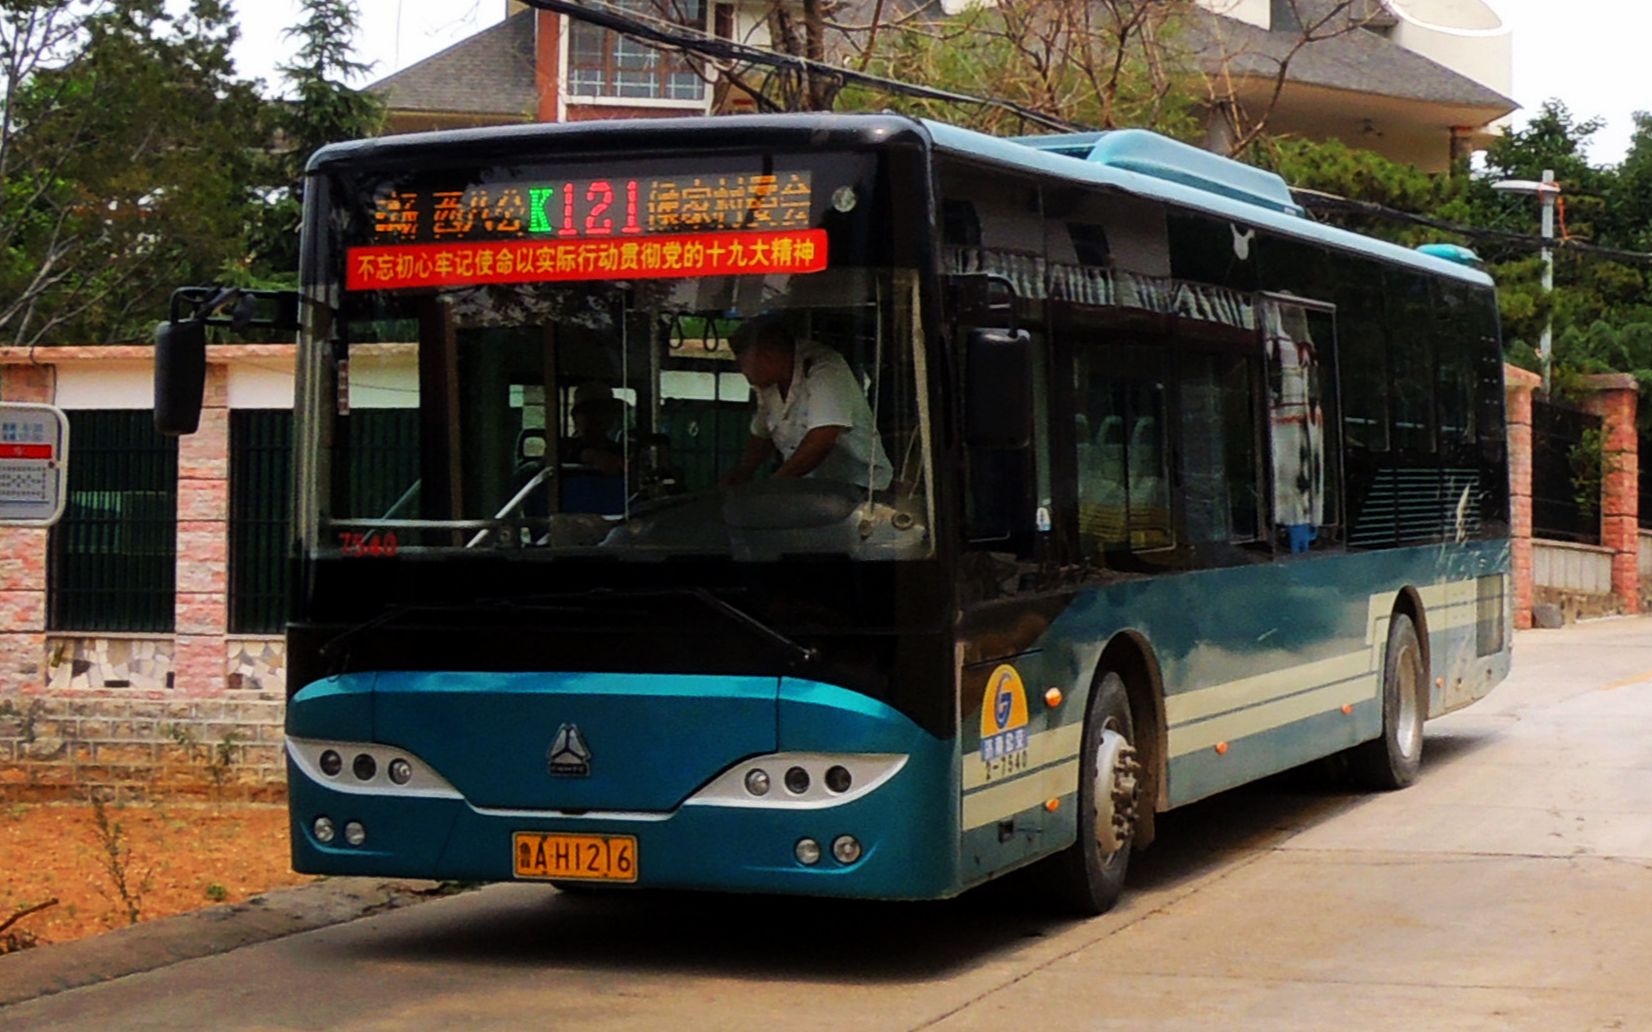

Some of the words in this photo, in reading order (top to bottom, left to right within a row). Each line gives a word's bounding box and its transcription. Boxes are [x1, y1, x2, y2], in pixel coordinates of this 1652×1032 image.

[529, 179, 641, 235] K121
[358, 239, 815, 281] 不忘初心牢记使命以实际行动贯彻党的十九大精神
